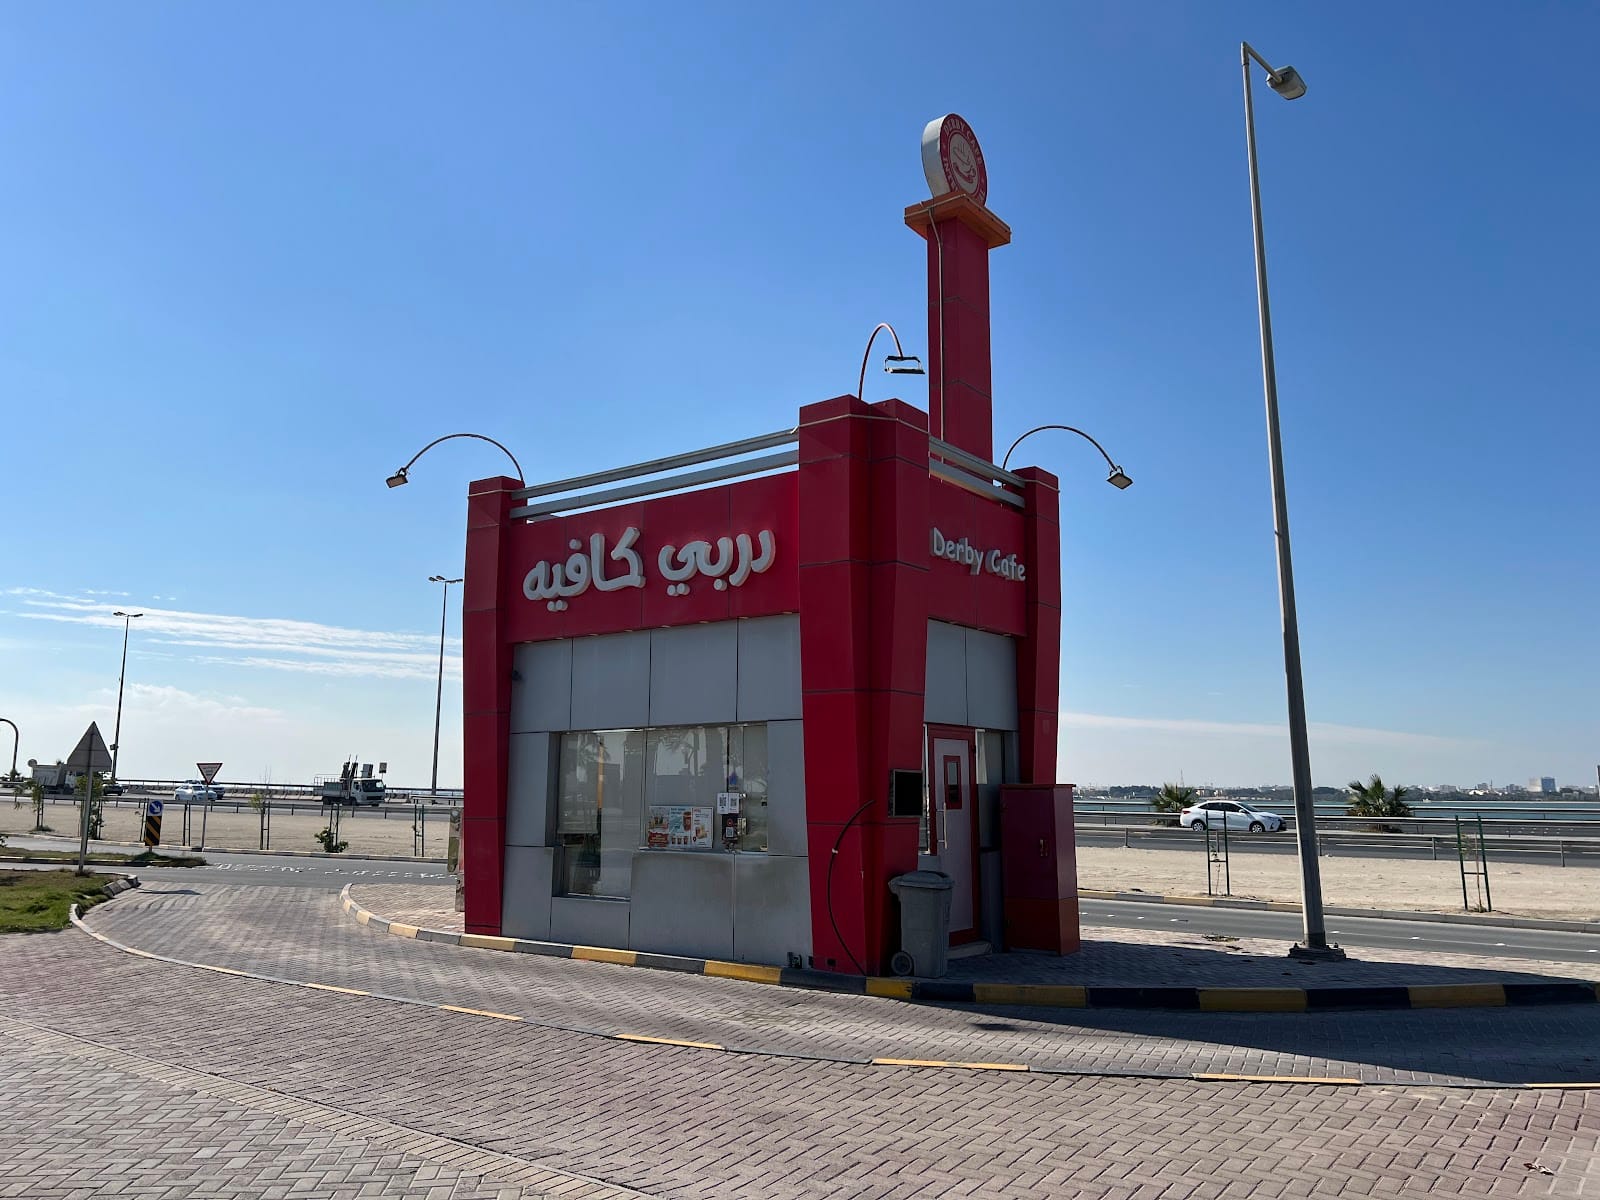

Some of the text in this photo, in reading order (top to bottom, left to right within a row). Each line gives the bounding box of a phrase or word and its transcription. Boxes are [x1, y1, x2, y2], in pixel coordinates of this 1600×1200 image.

[523, 526, 777, 611] دربي كافيه
[930, 527, 1026, 582] Derby Cafe
